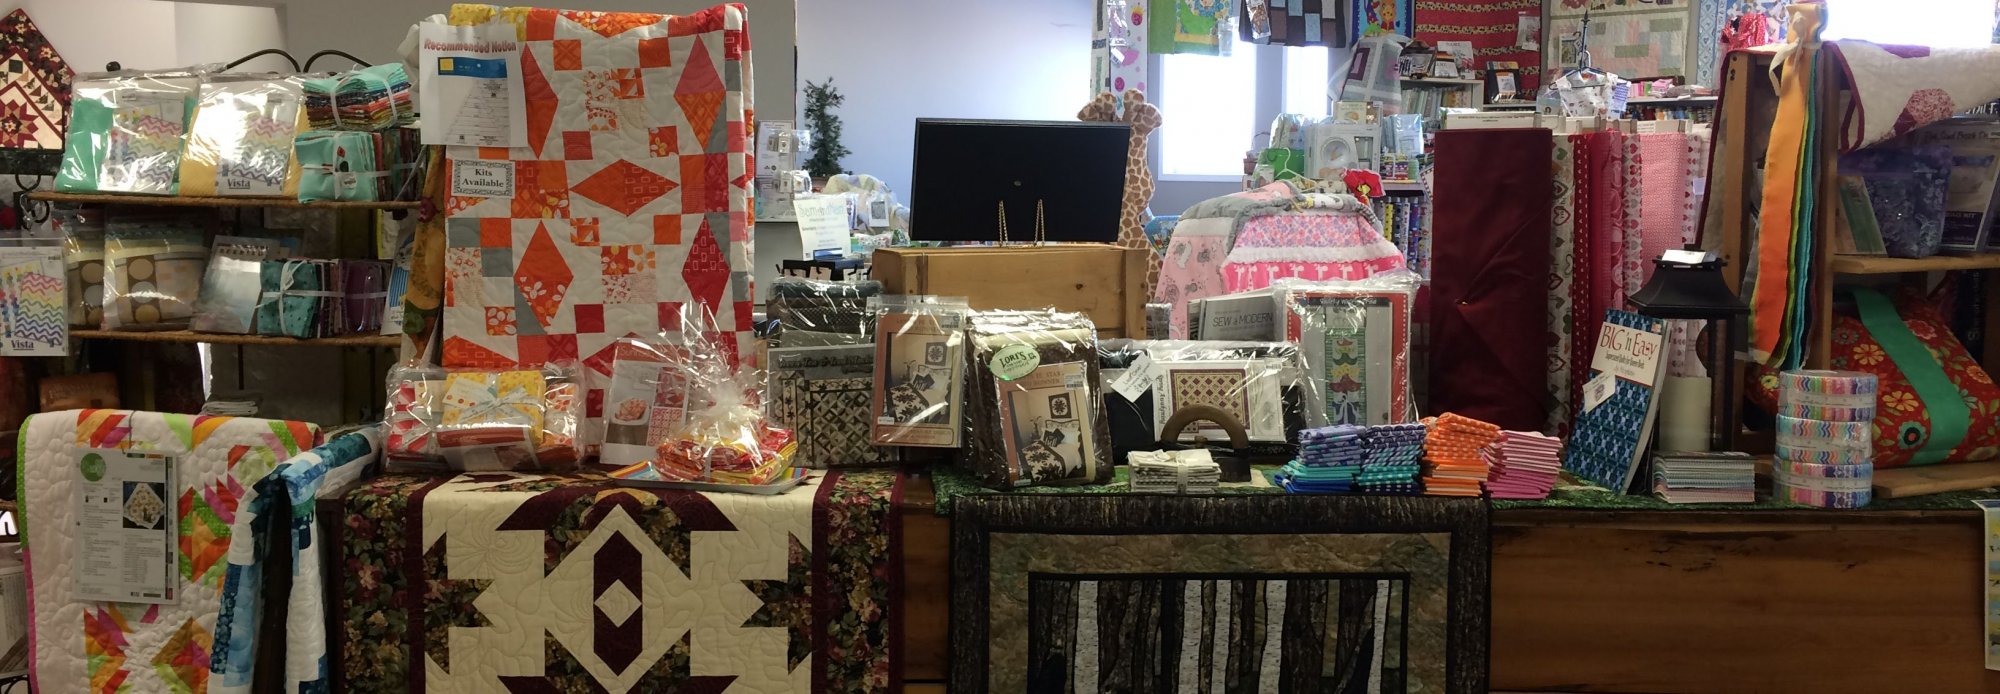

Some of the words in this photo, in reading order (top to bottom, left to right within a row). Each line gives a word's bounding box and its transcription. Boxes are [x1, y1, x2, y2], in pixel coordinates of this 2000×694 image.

[424, 38, 490, 53] Recommended
[491, 41, 517, 53] Notion
[475, 168, 493, 176] Kits
[227, 178, 250, 187] Vista
[462, 178, 504, 187] Available
[1212, 316, 1232, 327] SEW
[1238, 311, 1273, 325] MODERN
[11, 339, 34, 348] Vista
[1600, 325, 1625, 351] BIG
[1632, 332, 1658, 361] Easy
[999, 352, 1027, 368] LORI'S
